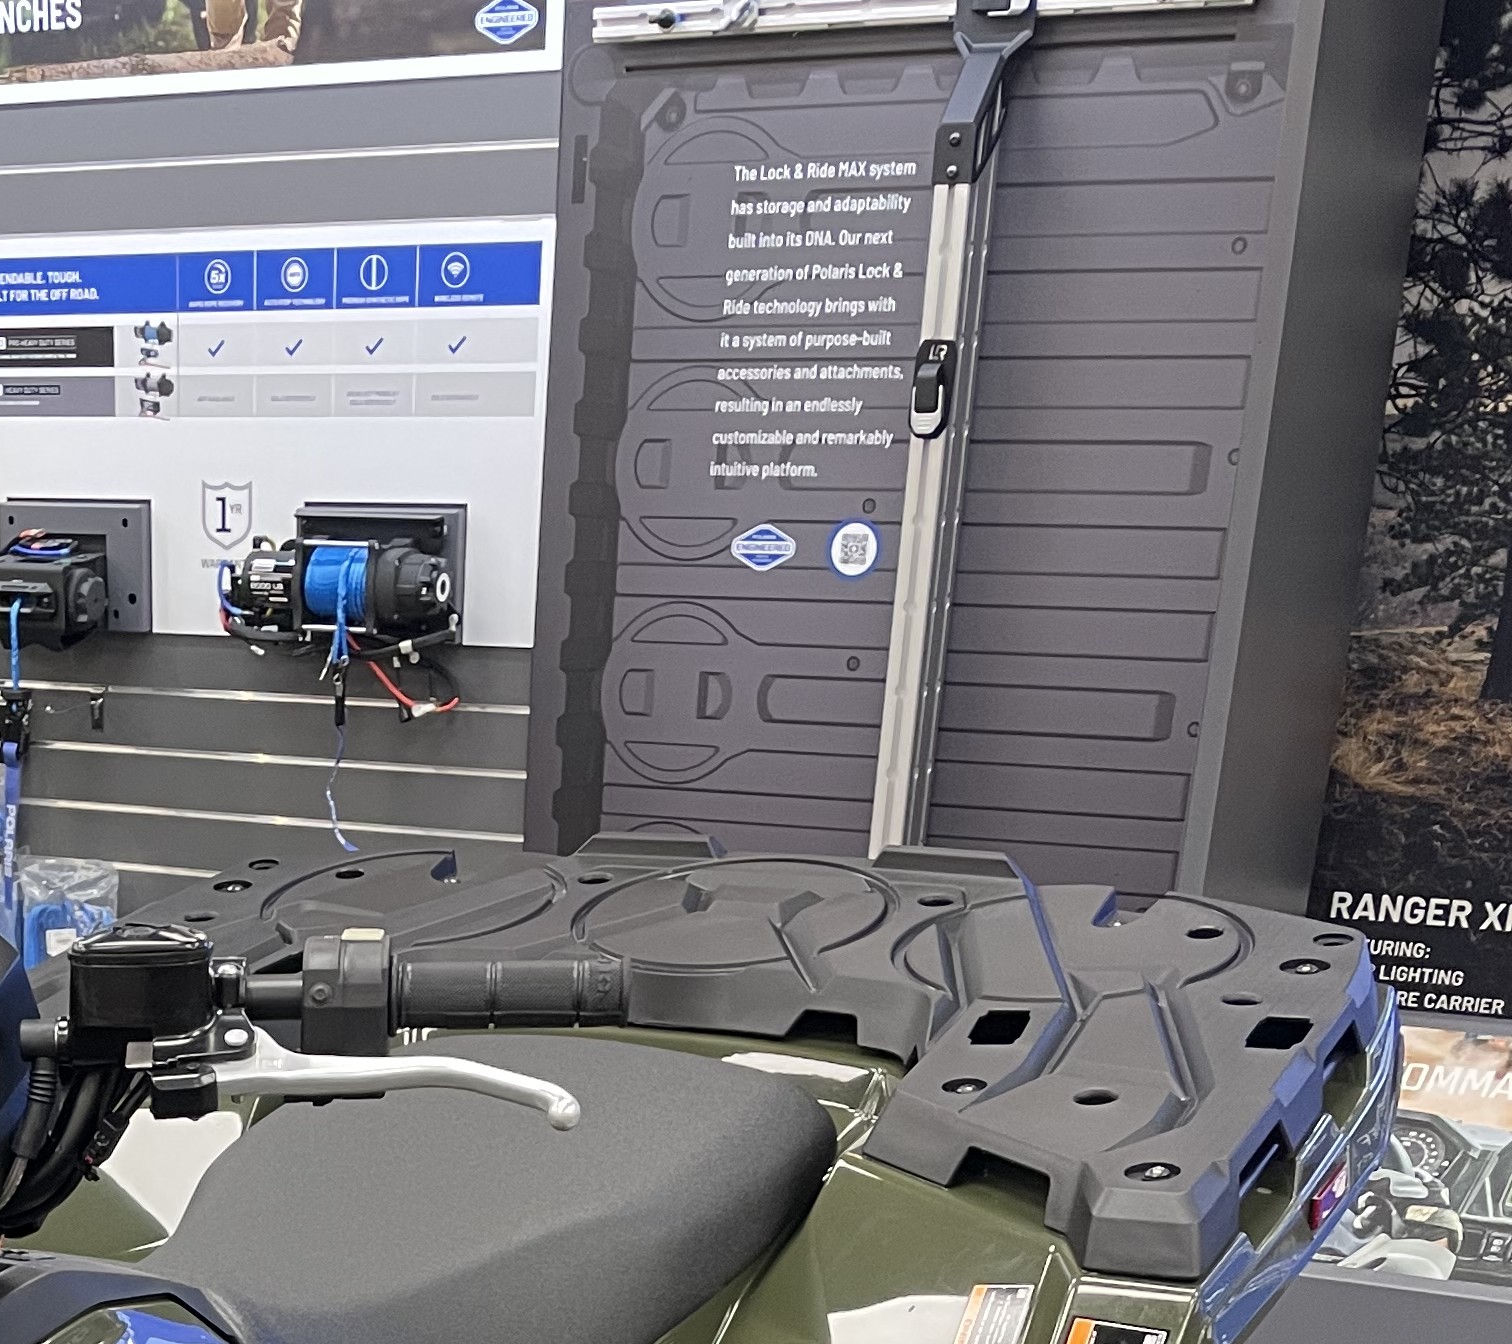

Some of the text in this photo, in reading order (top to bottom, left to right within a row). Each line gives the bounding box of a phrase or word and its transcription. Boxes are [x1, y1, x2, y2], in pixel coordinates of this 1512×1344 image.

[735, 161, 917, 181] The Lock & Ride MAX system
[731, 193, 912, 217] has storage and adaptability
[728, 229, 893, 249] built into its DNA. Our next
[47, 271, 82, 285] TOUGH.
[725, 262, 903, 286] generation of Polaris Lock &
[9, 289, 29, 302] FOR
[30, 289, 49, 302] THE
[49, 288, 68, 301] OFF
[70, 287, 99, 301] ROAD.
[723, 295, 896, 317] Ride technology brings with
[720, 329, 892, 351] it a system of purpose-built
[717, 363, 904, 380] accessories and attachments,
[714, 396, 863, 415] resulting in an endlessly
[712, 429, 894, 449] customizable and remarkably
[709, 461, 818, 479] intuitive platform.
[215, 496, 242, 533] 1 YR
[1329, 891, 1473, 929] RANGER
[1366, 938, 1432, 959] URING:
[1378, 964, 1465, 987] LIGHTING
[1395, 990, 1505, 1015] RE CARRIER
